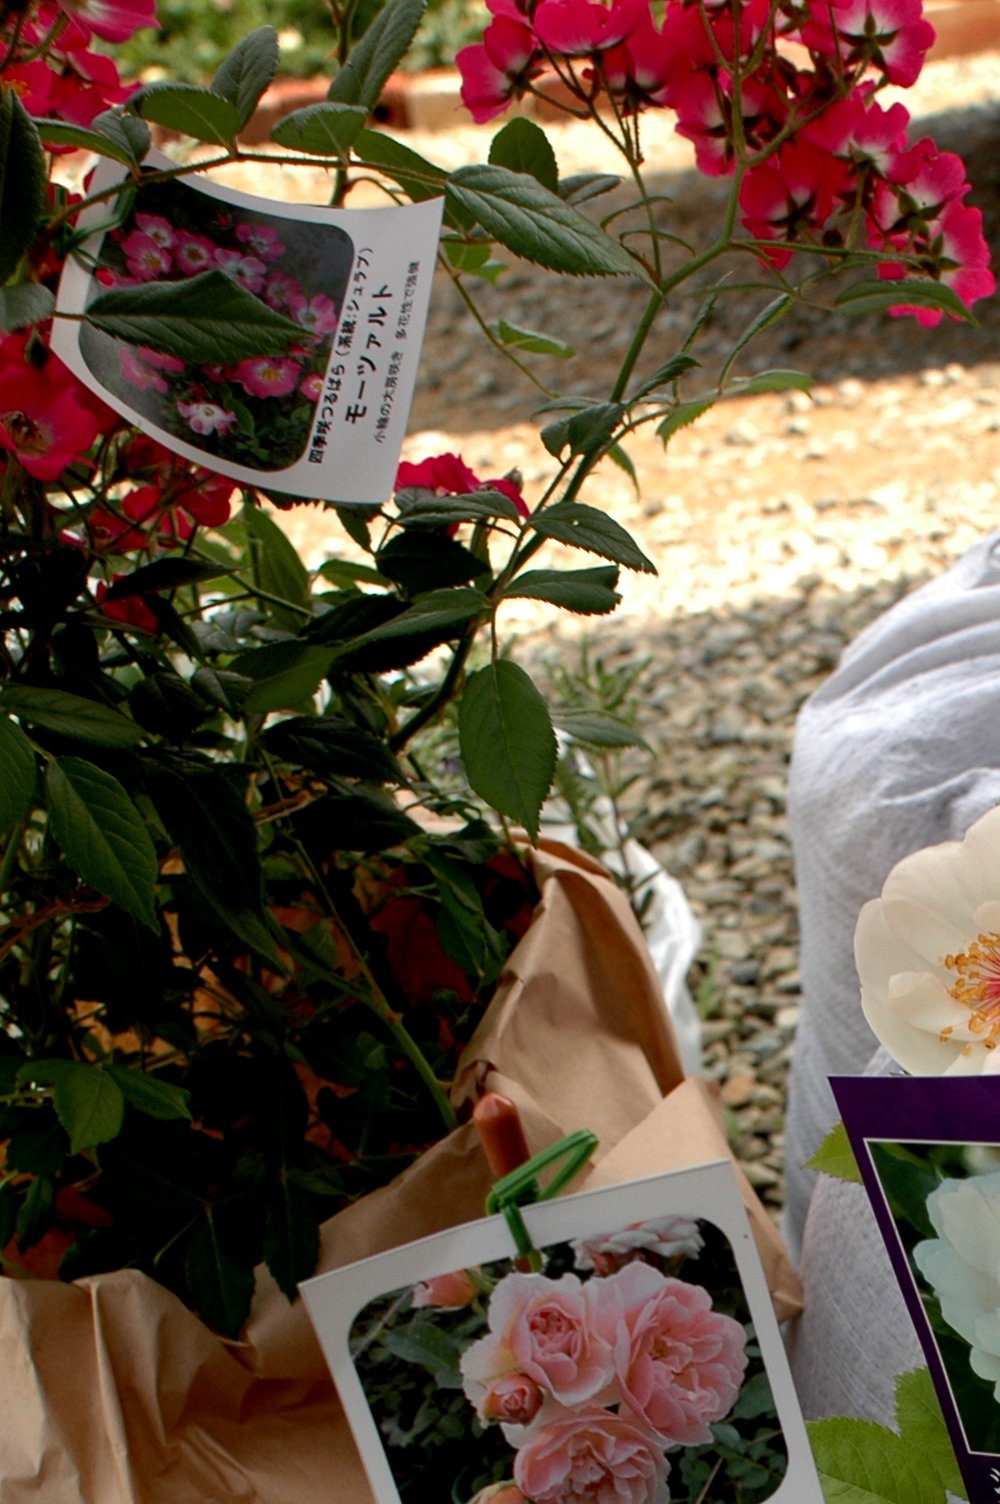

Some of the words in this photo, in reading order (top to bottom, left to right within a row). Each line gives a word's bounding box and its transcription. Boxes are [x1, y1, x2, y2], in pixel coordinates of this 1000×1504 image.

[345, 284, 393, 425] モーツァルト
